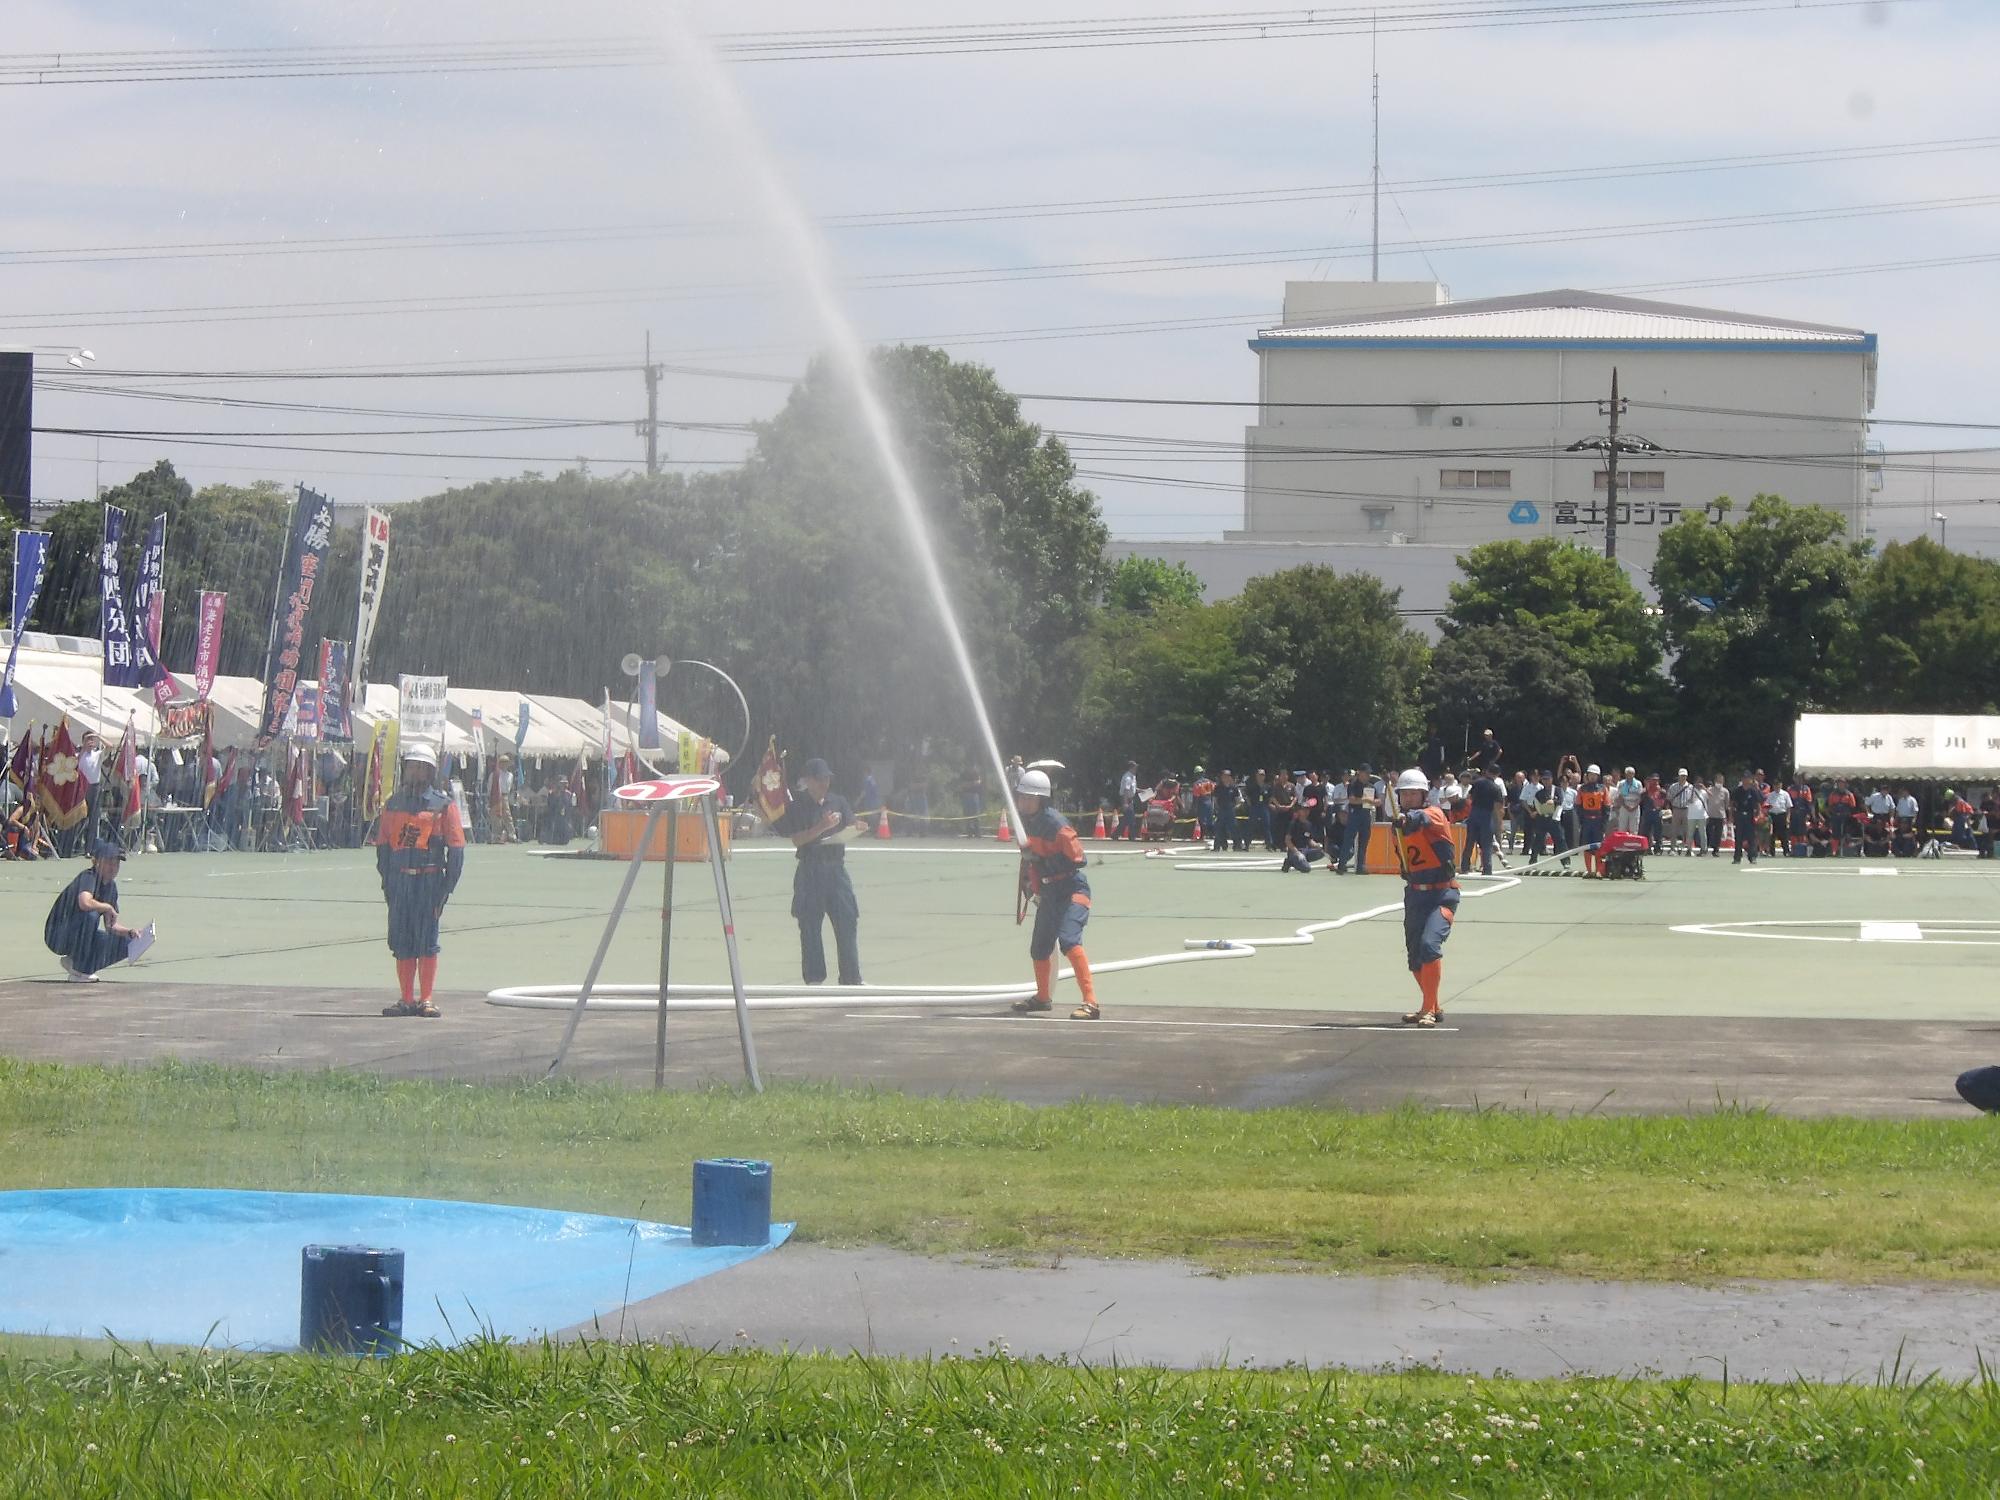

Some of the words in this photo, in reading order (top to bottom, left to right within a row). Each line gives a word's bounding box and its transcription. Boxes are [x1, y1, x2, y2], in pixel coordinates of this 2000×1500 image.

[1555, 500, 1723, 525] 富士ロジテク
[1588, 797, 1595, 808] 3
[1407, 846, 1426, 865] 2
